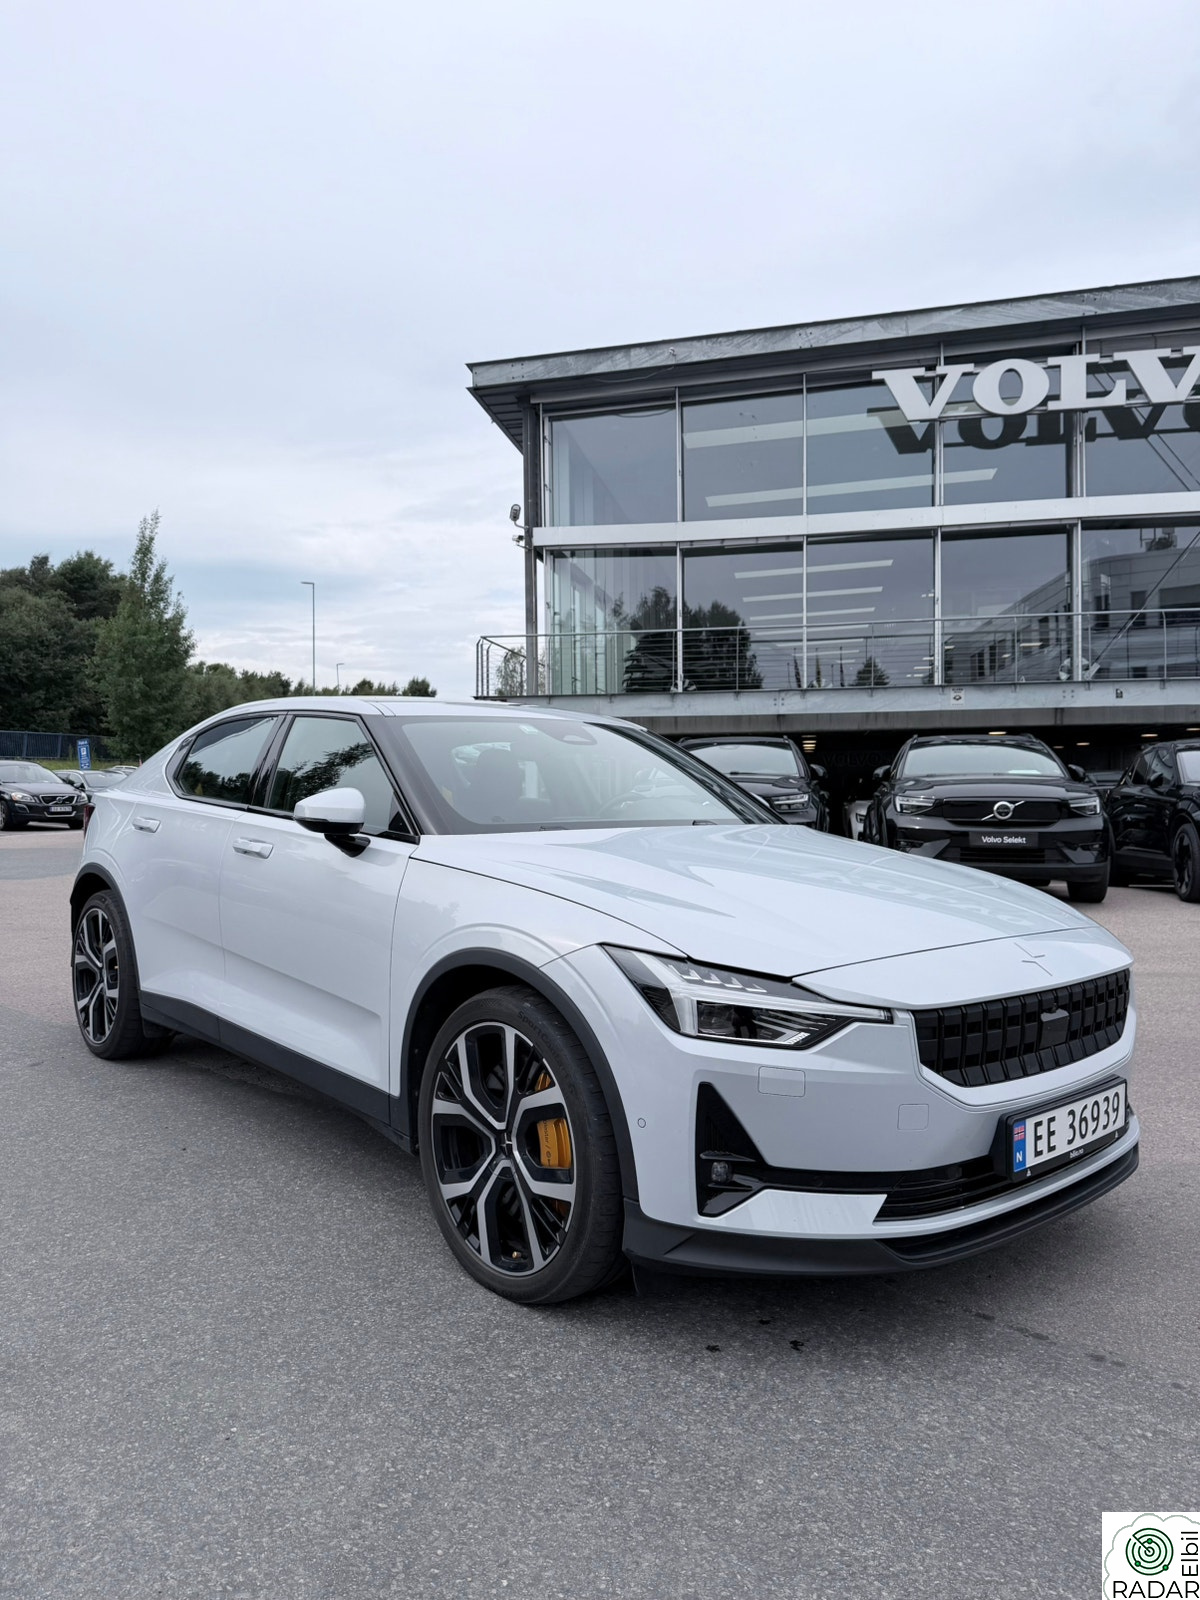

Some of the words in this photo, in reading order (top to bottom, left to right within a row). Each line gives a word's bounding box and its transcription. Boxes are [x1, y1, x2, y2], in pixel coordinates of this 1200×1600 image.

[982, 835, 1002, 843] Volvo
[1003, 836, 1026, 844] Selekt
[1034, 1117, 1056, 1158] EE
[1067, 1092, 1119, 1145] 36939
[1016, 1150, 1023, 1164] N
